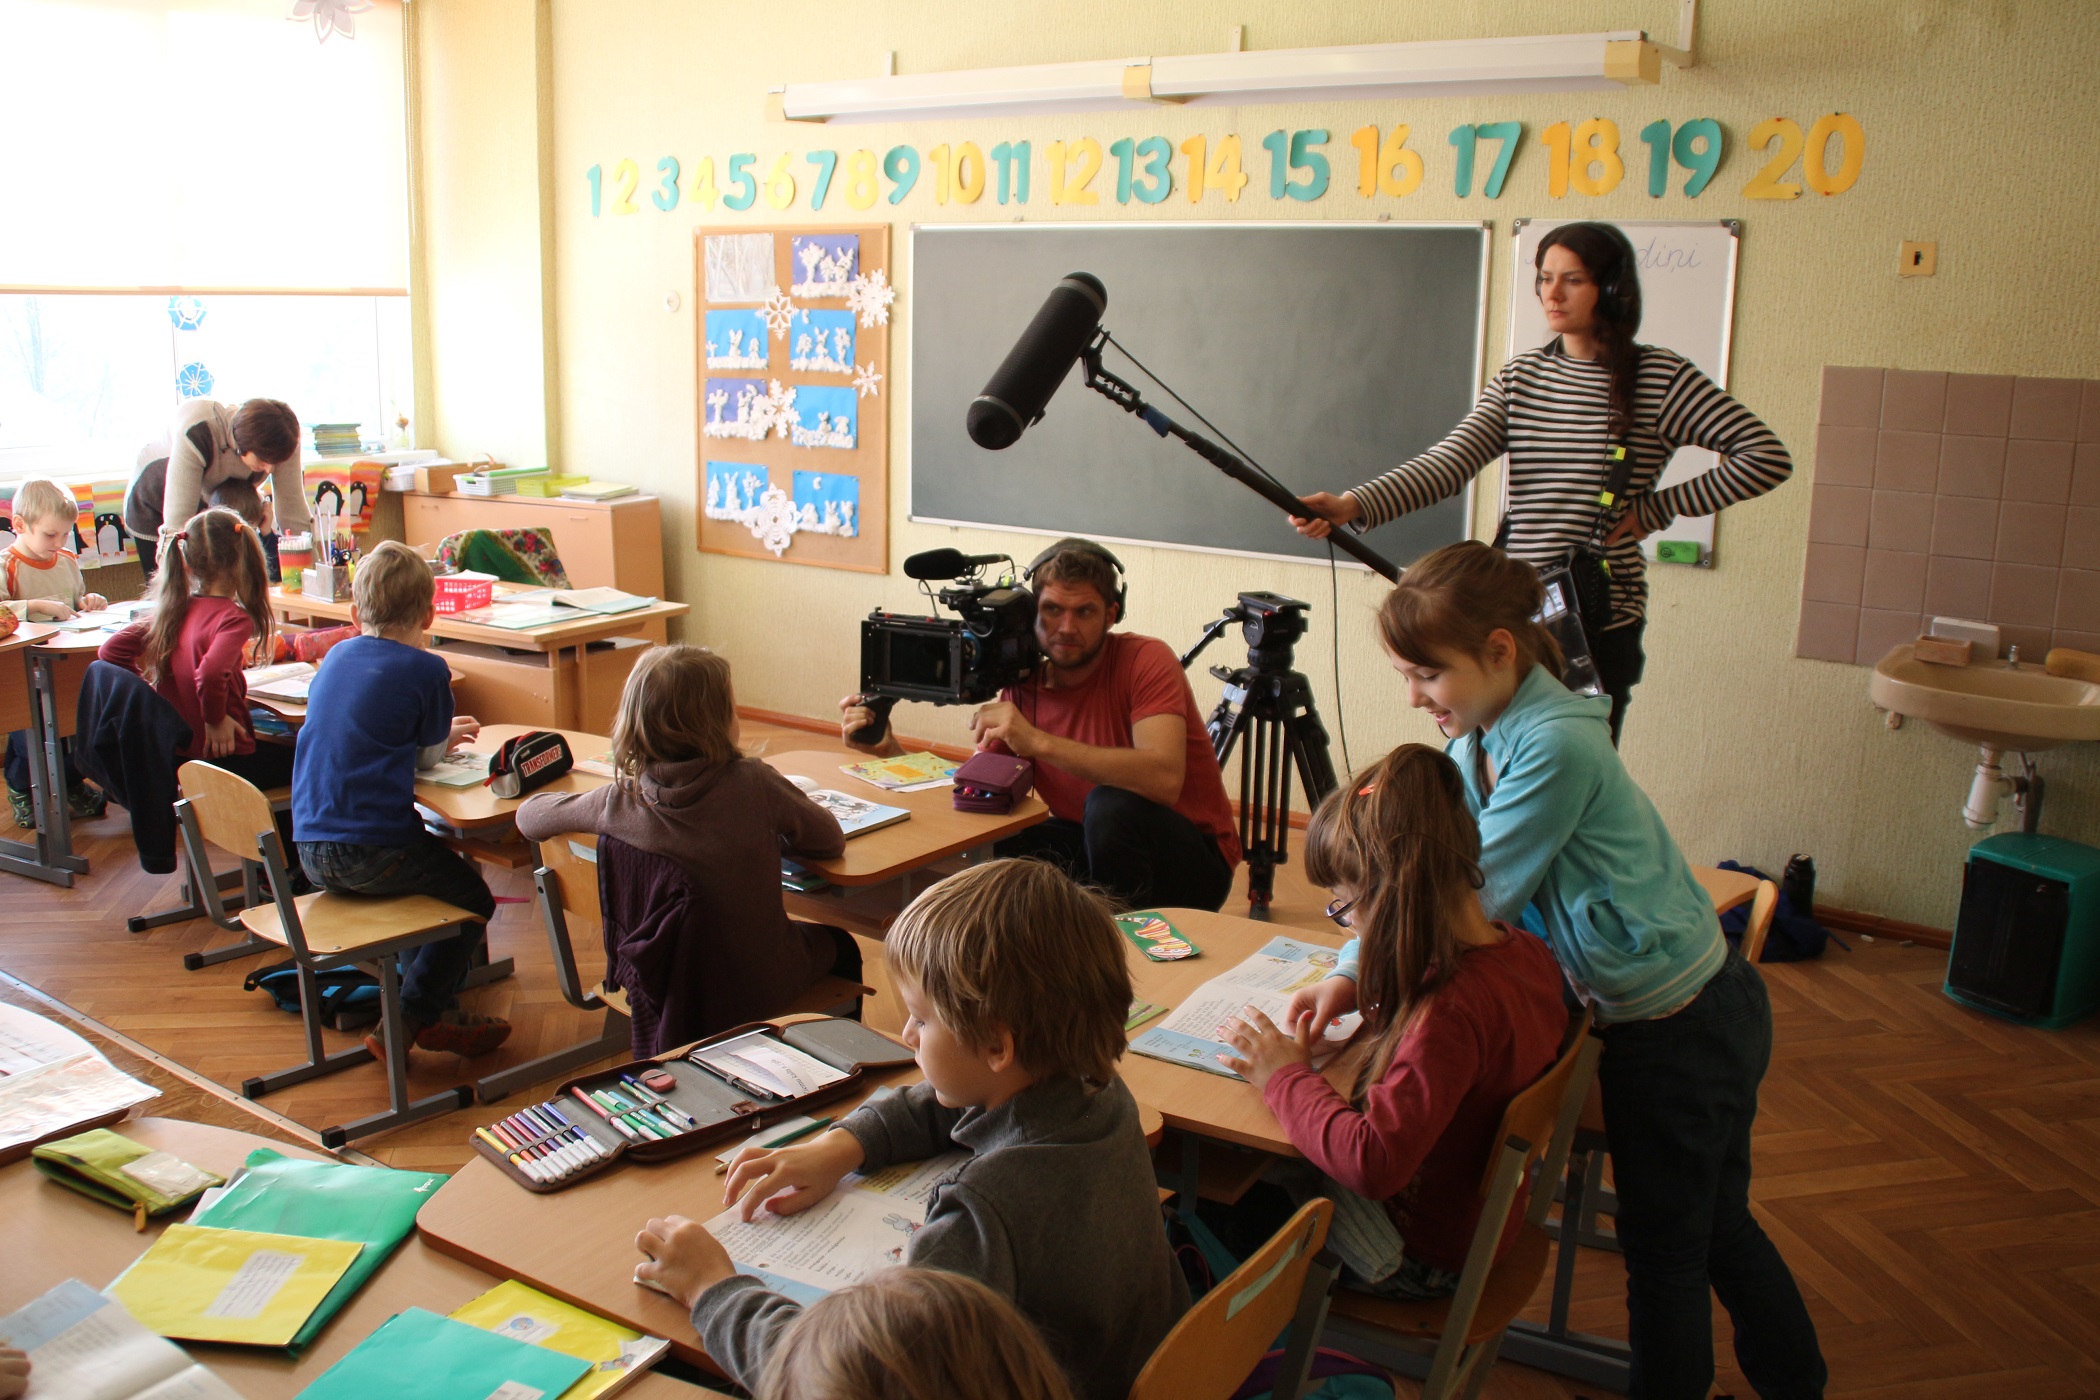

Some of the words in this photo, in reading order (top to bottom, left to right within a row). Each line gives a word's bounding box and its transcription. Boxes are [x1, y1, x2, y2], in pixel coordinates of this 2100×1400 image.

[586, 164, 602, 218] 1
[611, 158, 641, 215] 2
[651, 156, 680, 212] 3
[688, 156, 719, 212] 4
[722, 153, 756, 210] 5
[764, 152, 796, 210] 6
[806, 149, 837, 211] 7
[844, 148, 880, 211] 8
[883, 144, 921, 206] 9
[929, 140, 986, 206] 10
[990, 139, 1032, 206] 11
[1045, 136, 1103, 206] 12
[1110, 135, 1174, 205] 13
[1180, 133, 1249, 203] 14
[1262, 128, 1331, 201] 15
[1350, 124, 1425, 199] 16
[1448, 121, 1522, 199] 17
[1541, 117, 1625, 199] 18
[1640, 117, 1722, 199] 19
[1741, 112, 1866, 200] 20
